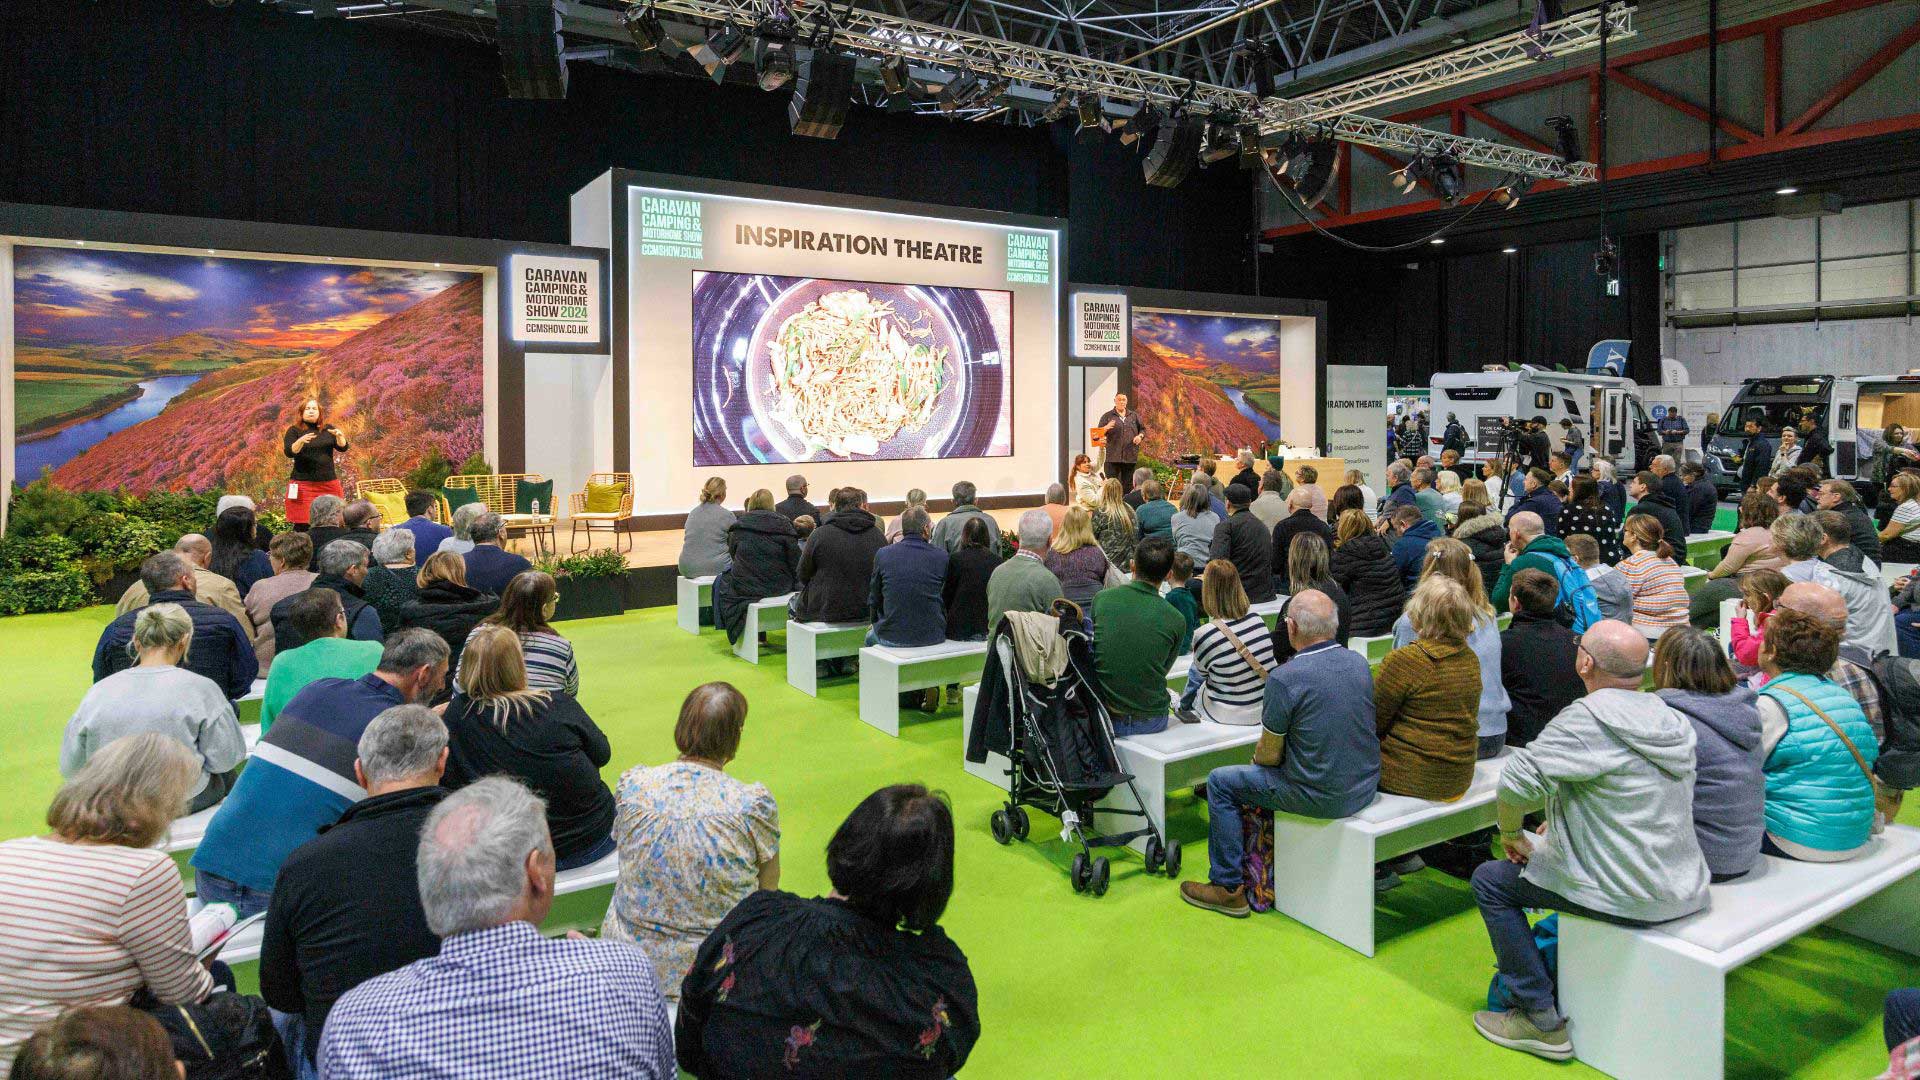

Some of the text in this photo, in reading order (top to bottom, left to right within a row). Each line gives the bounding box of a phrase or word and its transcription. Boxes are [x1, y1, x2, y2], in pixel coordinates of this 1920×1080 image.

[642, 197, 700, 217] CARAVAN
[642, 214, 702, 231] CAMPING &
[736, 224, 982, 264] INSPIRATION THEATRE
[1008, 234, 1048, 250] CARAVAN
[642, 244, 703, 260] CCMSHOW.CO.UK
[1008, 246, 1041, 260] CAMPING
[526, 268, 587, 284] CARAVAN
[526, 282, 588, 296] CAMPING &
[526, 294, 588, 306] MOTORHOME
[526, 304, 588, 318] SHOW 2024
[1084, 302, 1120, 314] CARAVAN
[1084, 312, 1120, 322] CAMPING &
[526, 324, 588, 334] CCMSHOW.CO.UK
[1084, 322, 1120, 330] MOTORHOME
[1084, 330, 1120, 340] SHOW 2024
